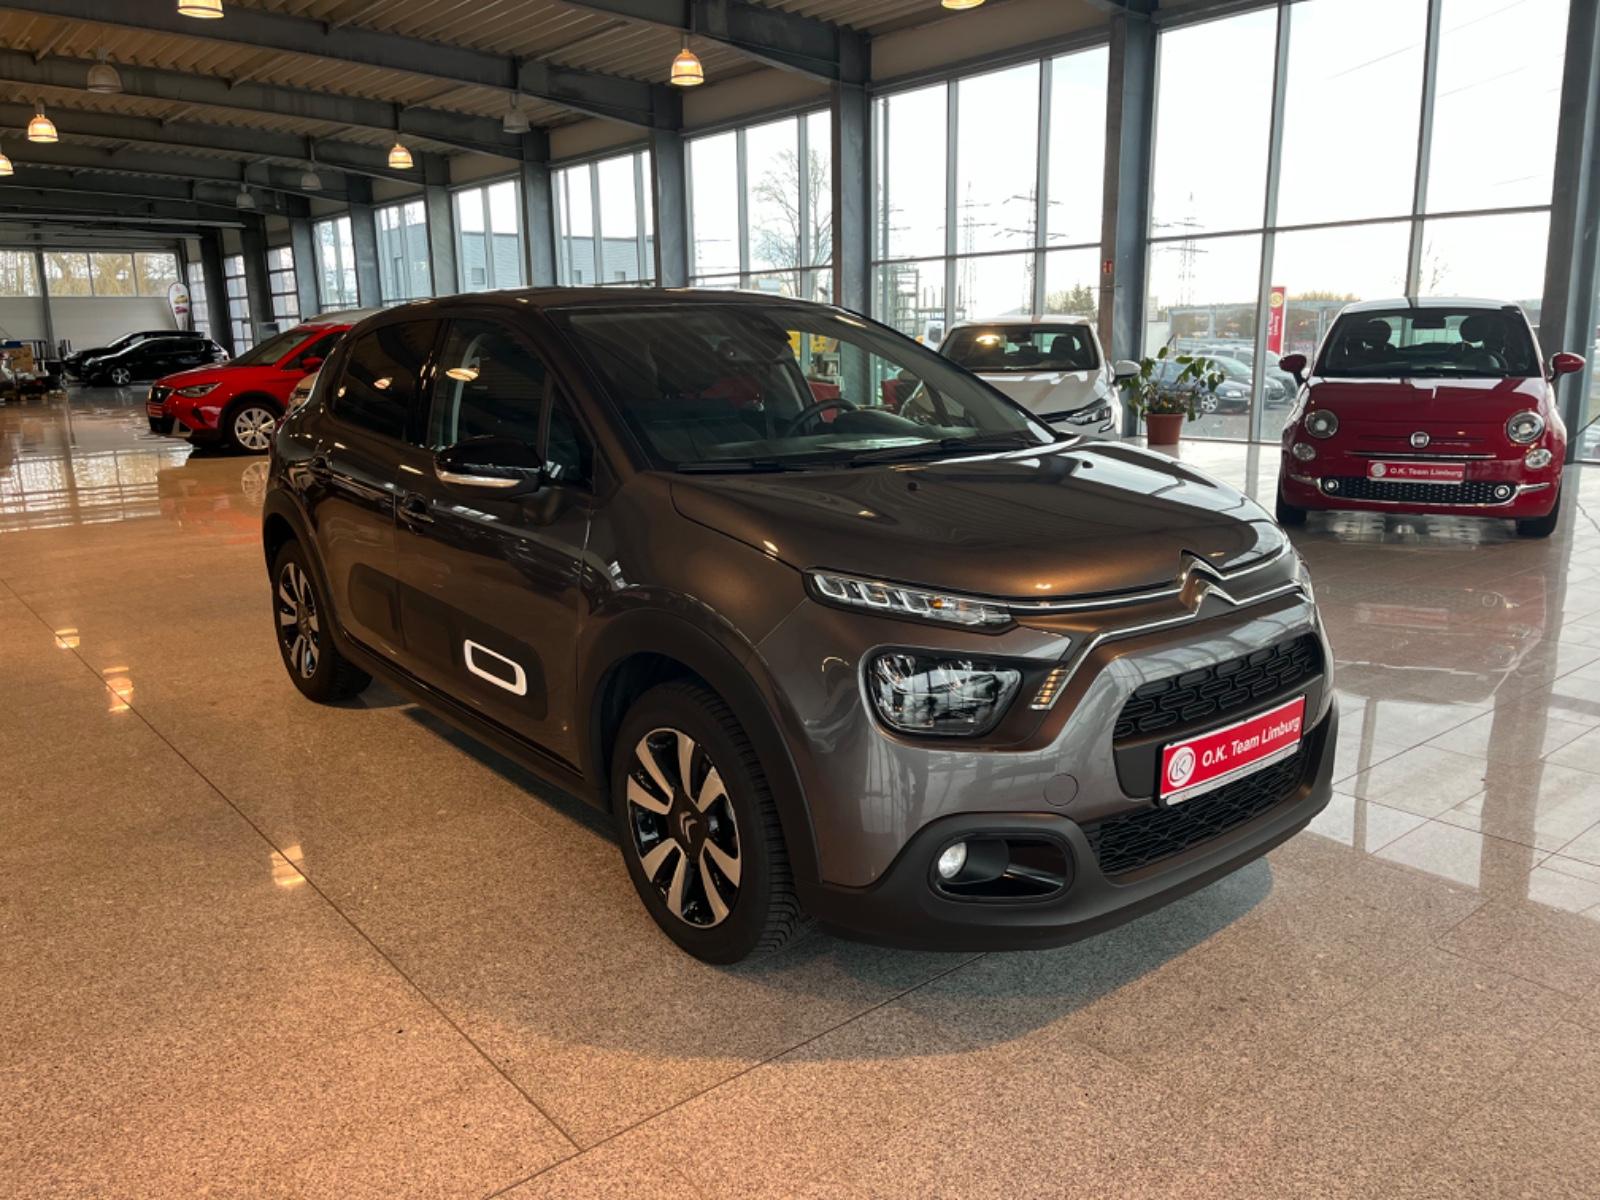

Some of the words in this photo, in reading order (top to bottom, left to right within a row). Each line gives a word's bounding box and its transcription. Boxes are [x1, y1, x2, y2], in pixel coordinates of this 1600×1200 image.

[1408, 467, 1429, 476] Team
[1202, 744, 1228, 767] O.K.
[1231, 736, 1260, 756] Team
[1262, 717, 1301, 744] Limburg
